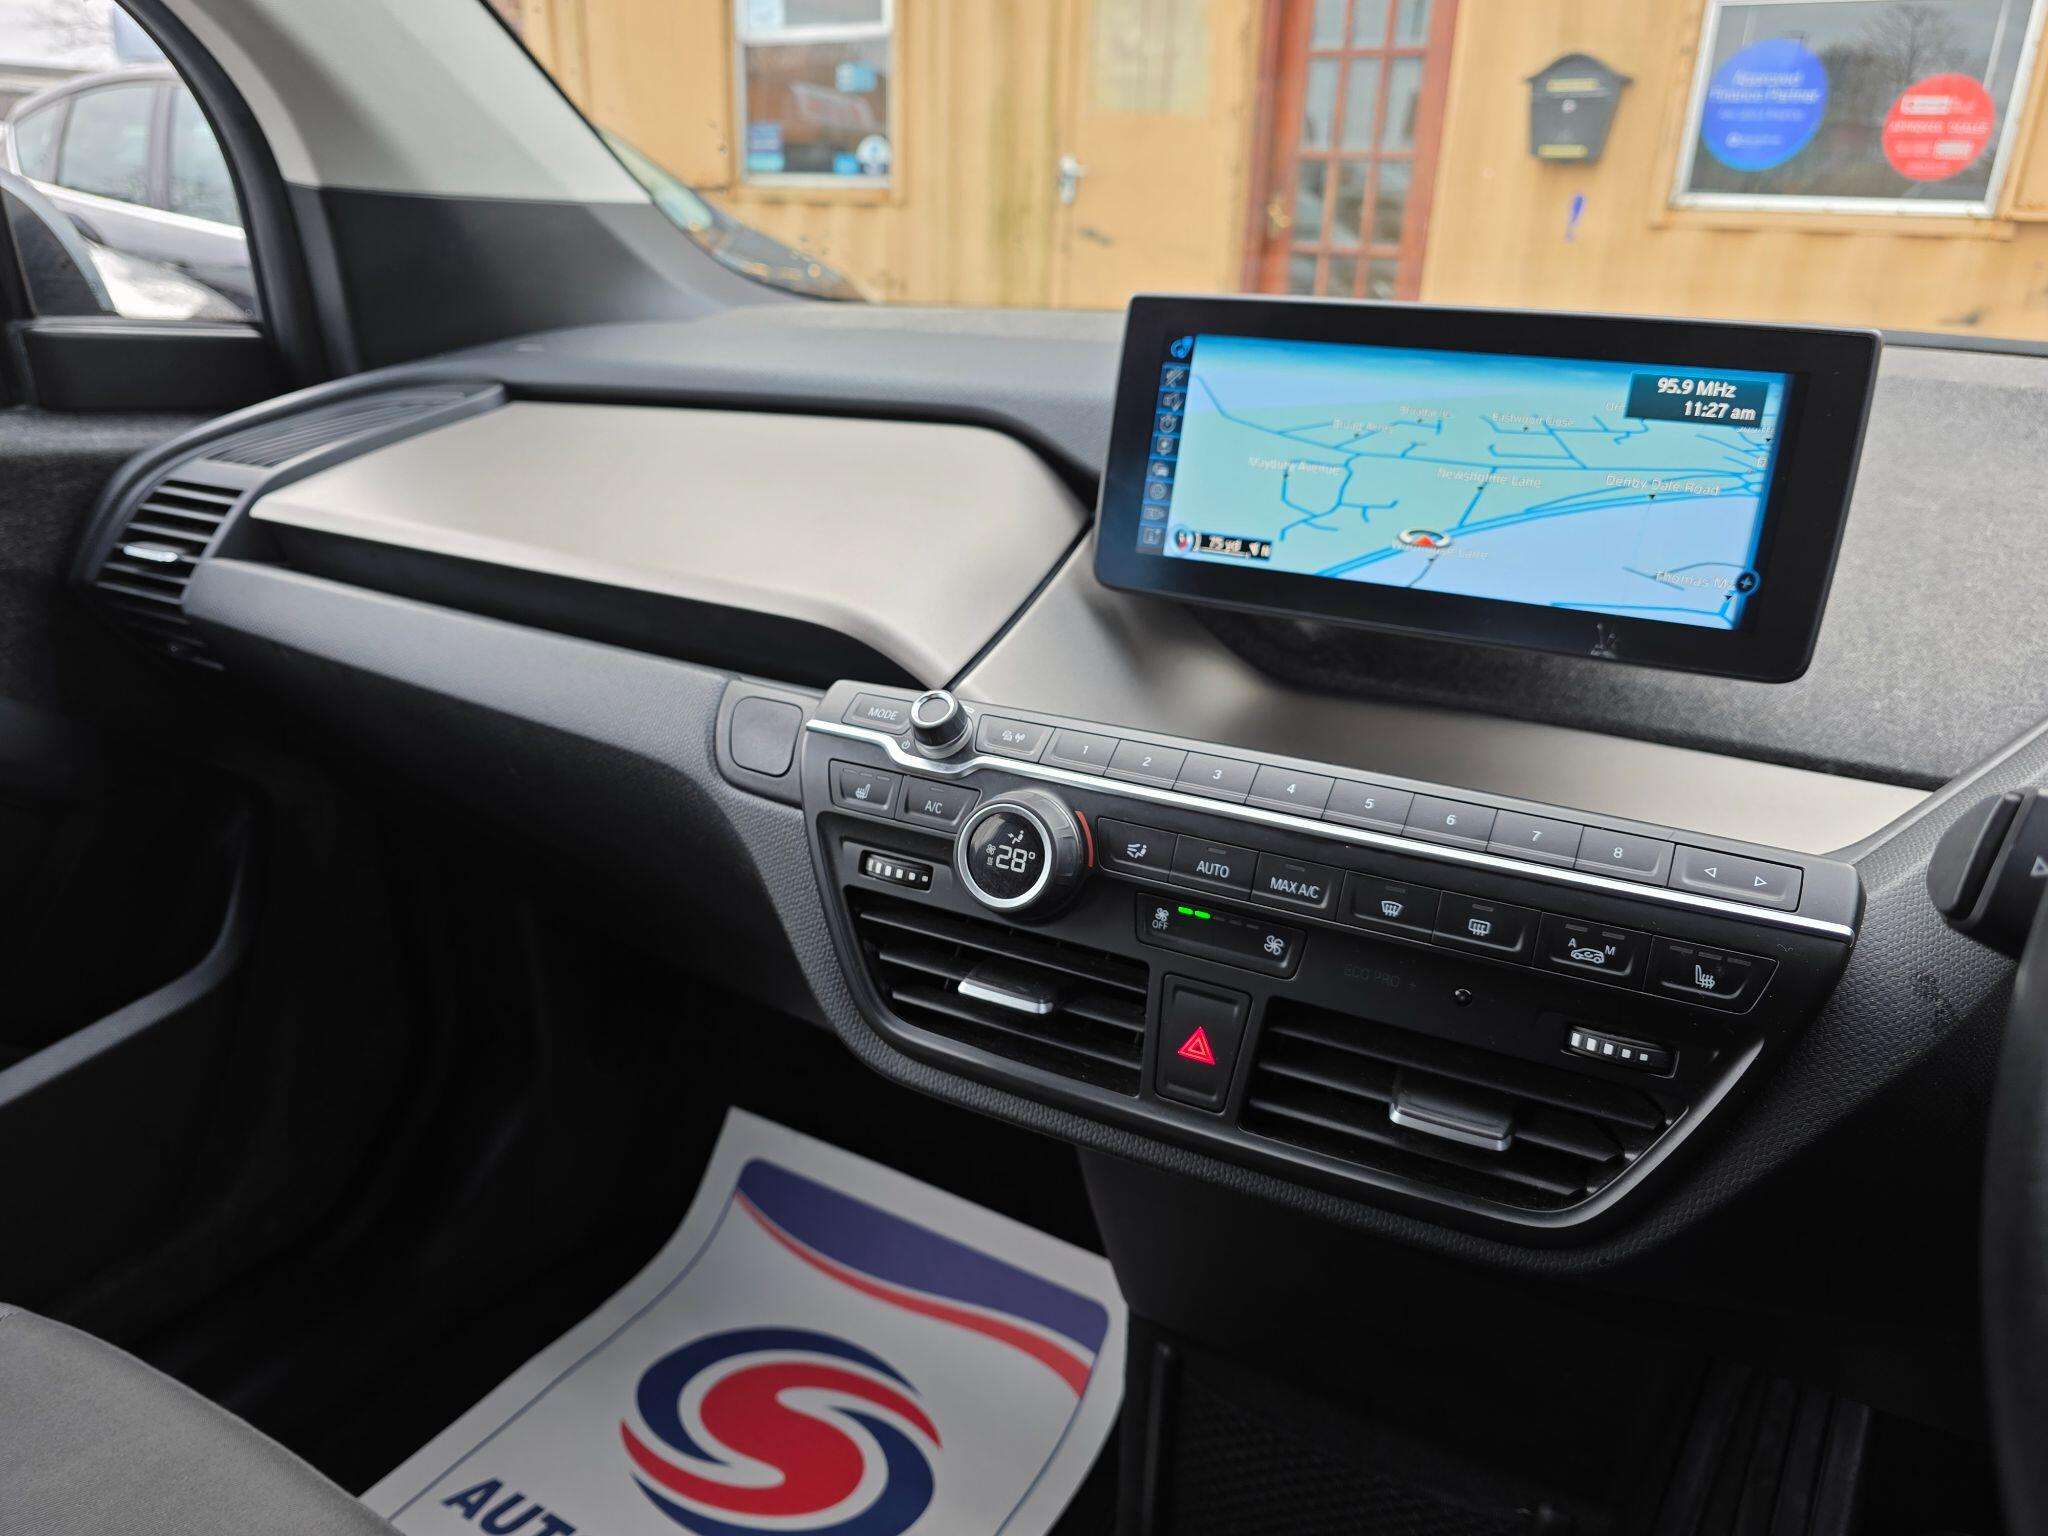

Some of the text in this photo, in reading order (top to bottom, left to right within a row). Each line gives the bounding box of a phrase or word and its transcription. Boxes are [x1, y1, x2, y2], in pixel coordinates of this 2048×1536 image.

[1657, 376, 1738, 398] 95.9 MHz
[1683, 400, 1757, 421] 11:27 am
[1511, 474, 1542, 488] Lane
[1606, 474, 1721, 496] Denby Dale Road
[1656, 569, 1710, 586] Thomas
[867, 706, 900, 721] MODE
[1081, 744, 1089, 756] 1
[1142, 756, 1152, 768] 2
[1211, 769, 1223, 781] 3
[1285, 783, 1297, 795] 4
[924, 799, 943, 815] A/C
[1364, 798, 1375, 810] 5
[1446, 814, 1457, 827] 6
[1531, 830, 1541, 842] 7
[1612, 846, 1623, 859] 8
[1195, 859, 1230, 880] AUTO
[1270, 876, 1320, 900] MAX A/C
[1151, 920, 1169, 931] OFF
[1567, 937, 1577, 948] A
[1604, 945, 1617, 957] M
[442, 1476, 582, 1536] AUT
